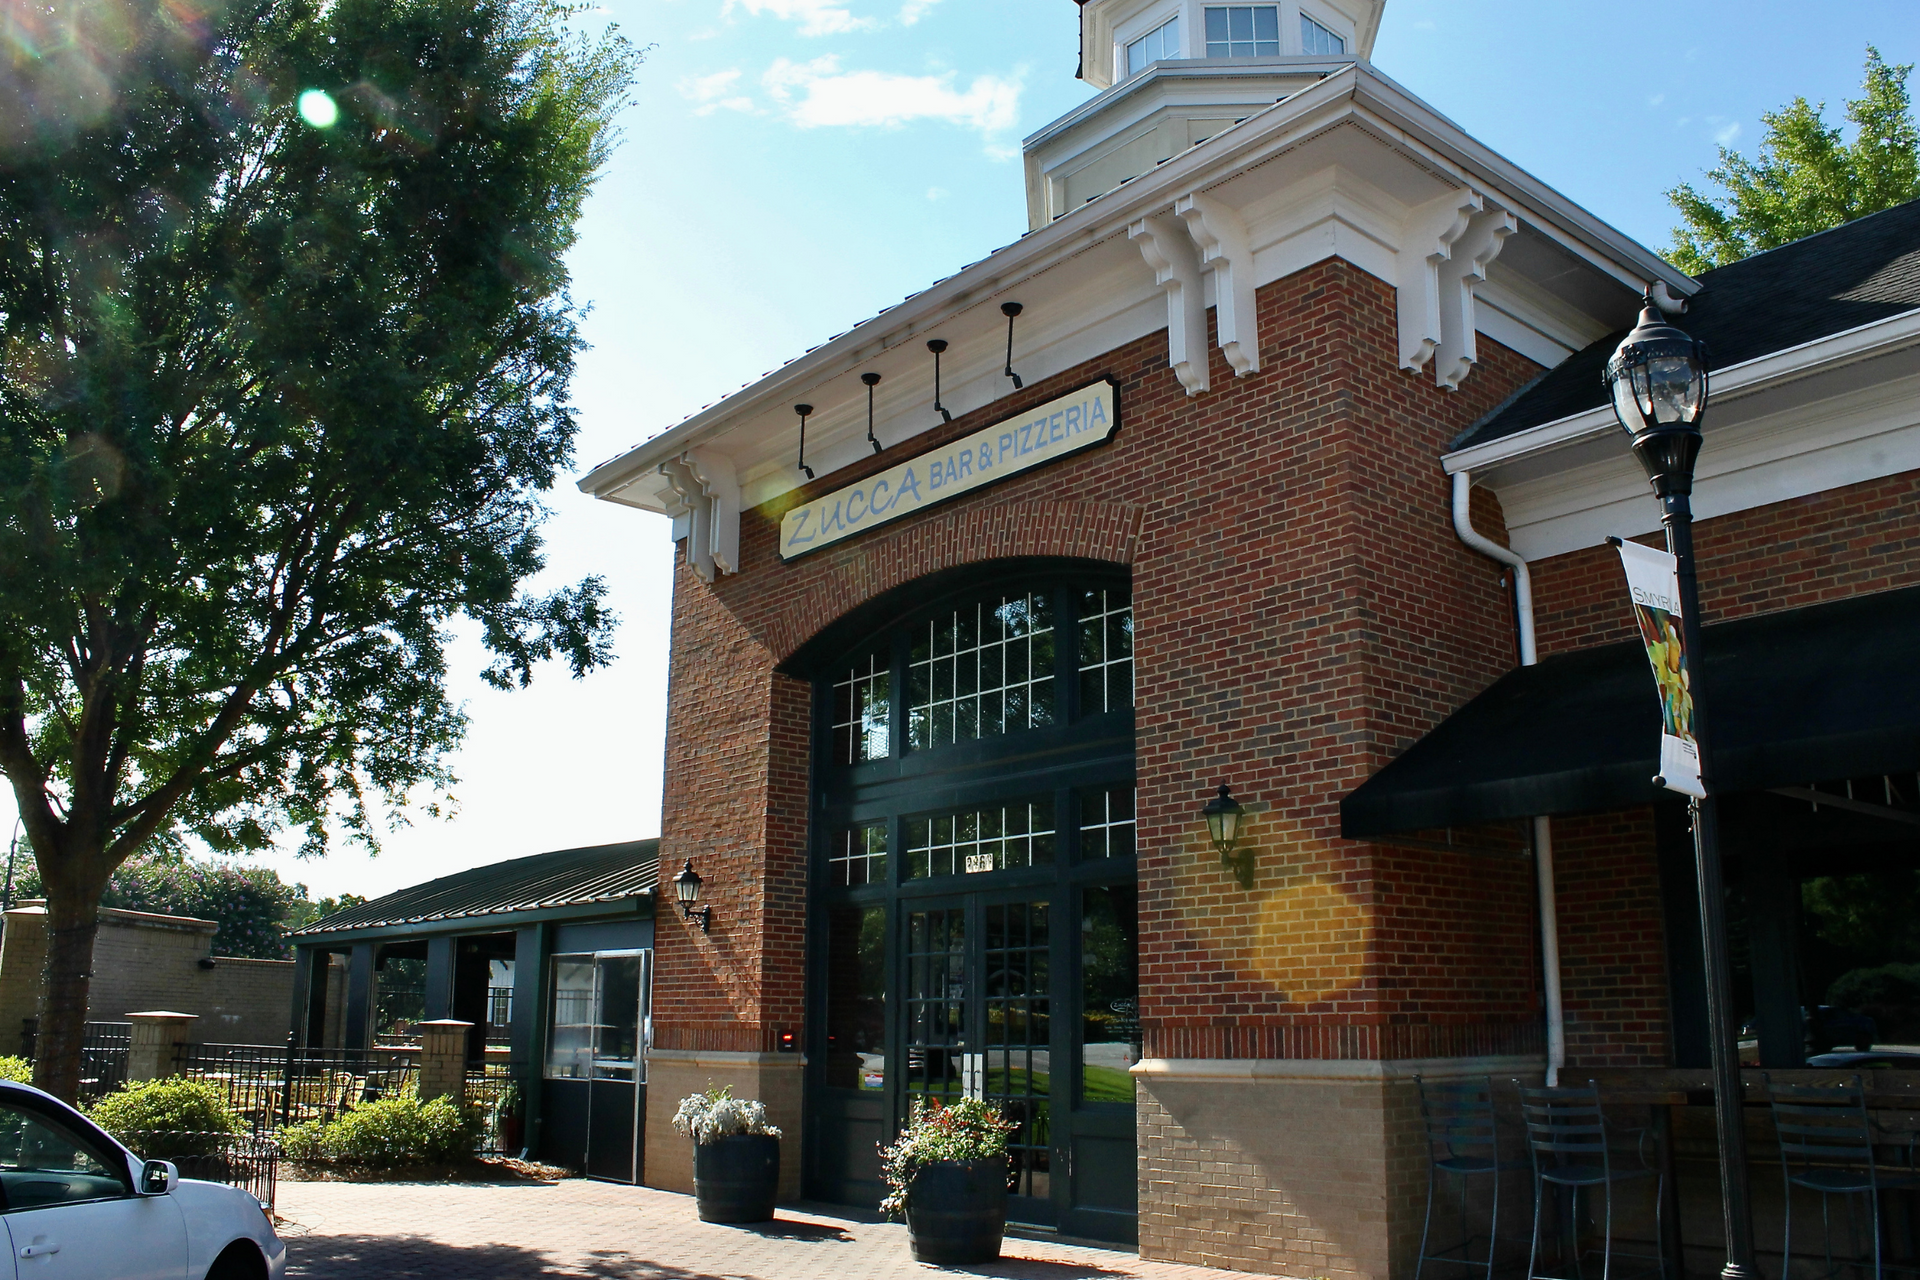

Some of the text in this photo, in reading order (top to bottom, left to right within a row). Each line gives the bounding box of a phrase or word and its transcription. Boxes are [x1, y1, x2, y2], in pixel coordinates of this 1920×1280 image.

[788, 396, 1107, 547] ZUCCA BAR & PIZZERIA
